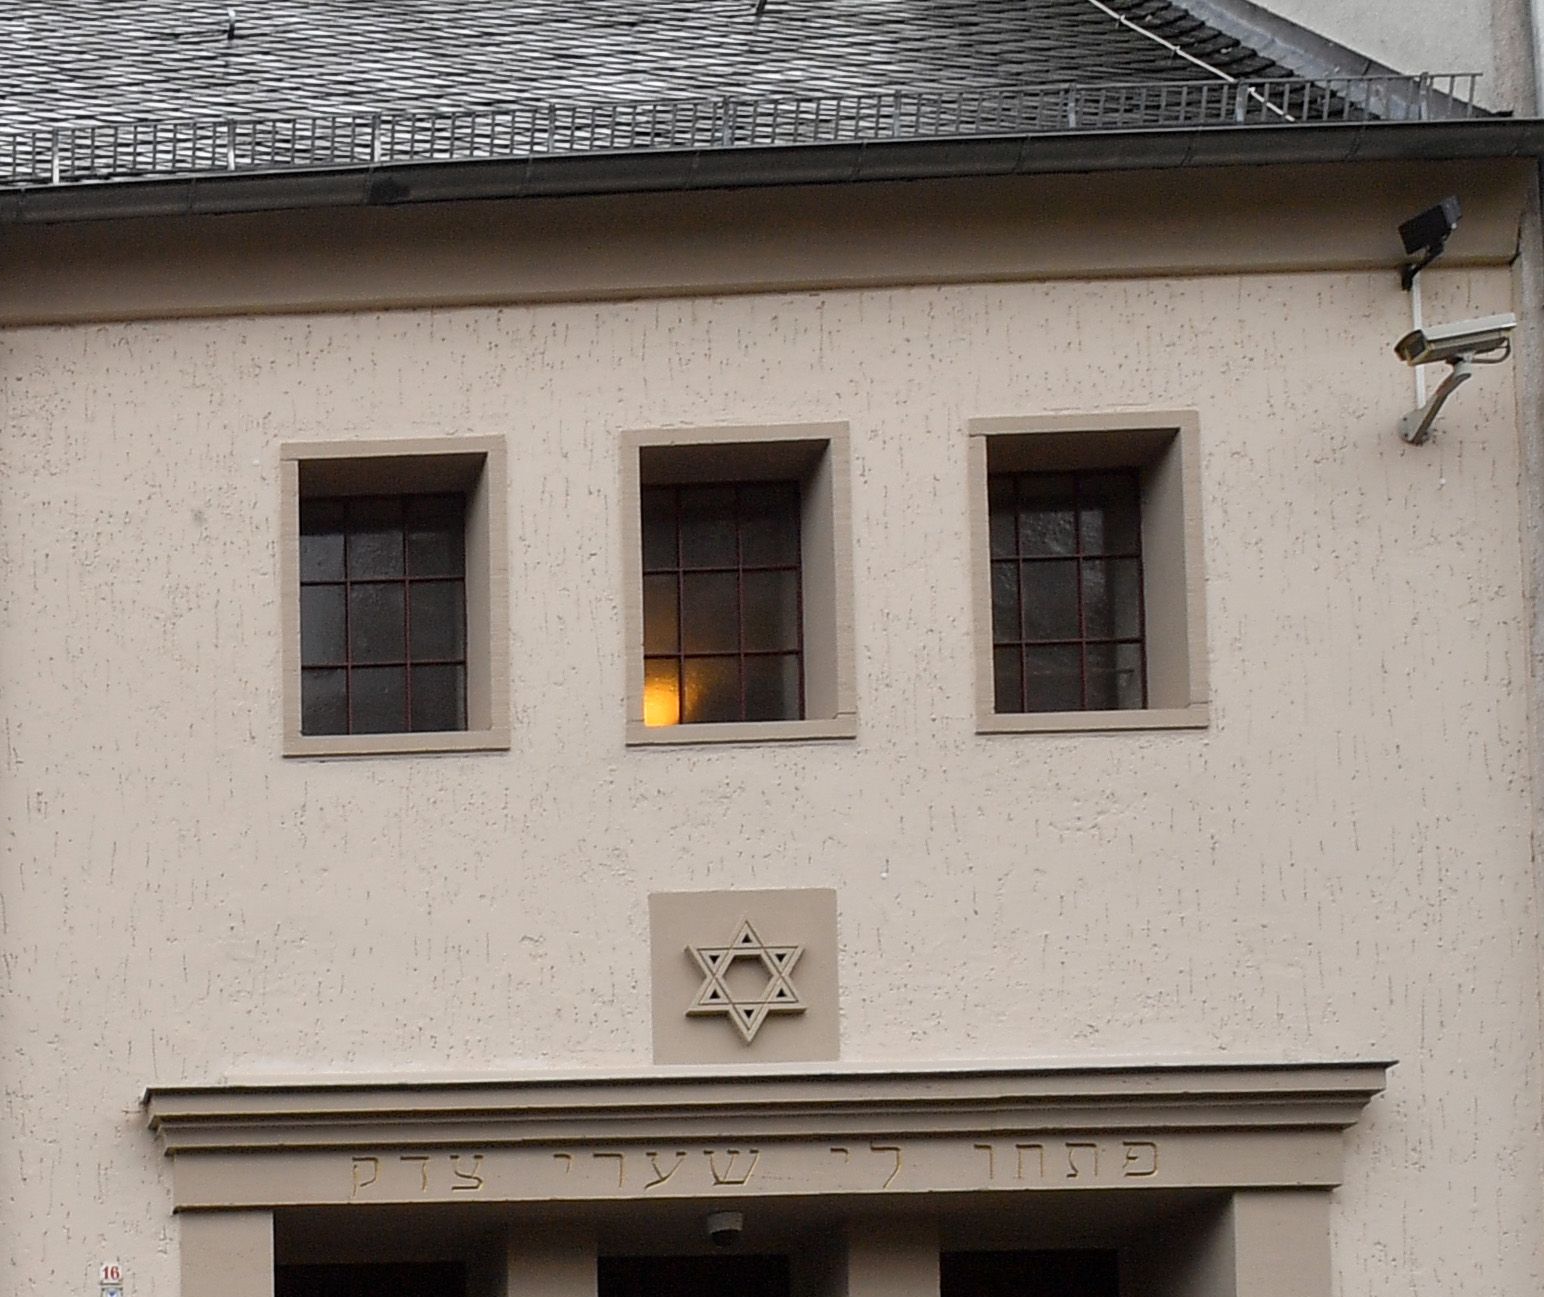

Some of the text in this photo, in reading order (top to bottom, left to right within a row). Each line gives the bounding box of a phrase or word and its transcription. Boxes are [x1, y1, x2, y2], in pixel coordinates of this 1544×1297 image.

[352, 1141, 1159, 1198] פתחו לי שערי צדק
[103, 1265, 120, 1280] 16
